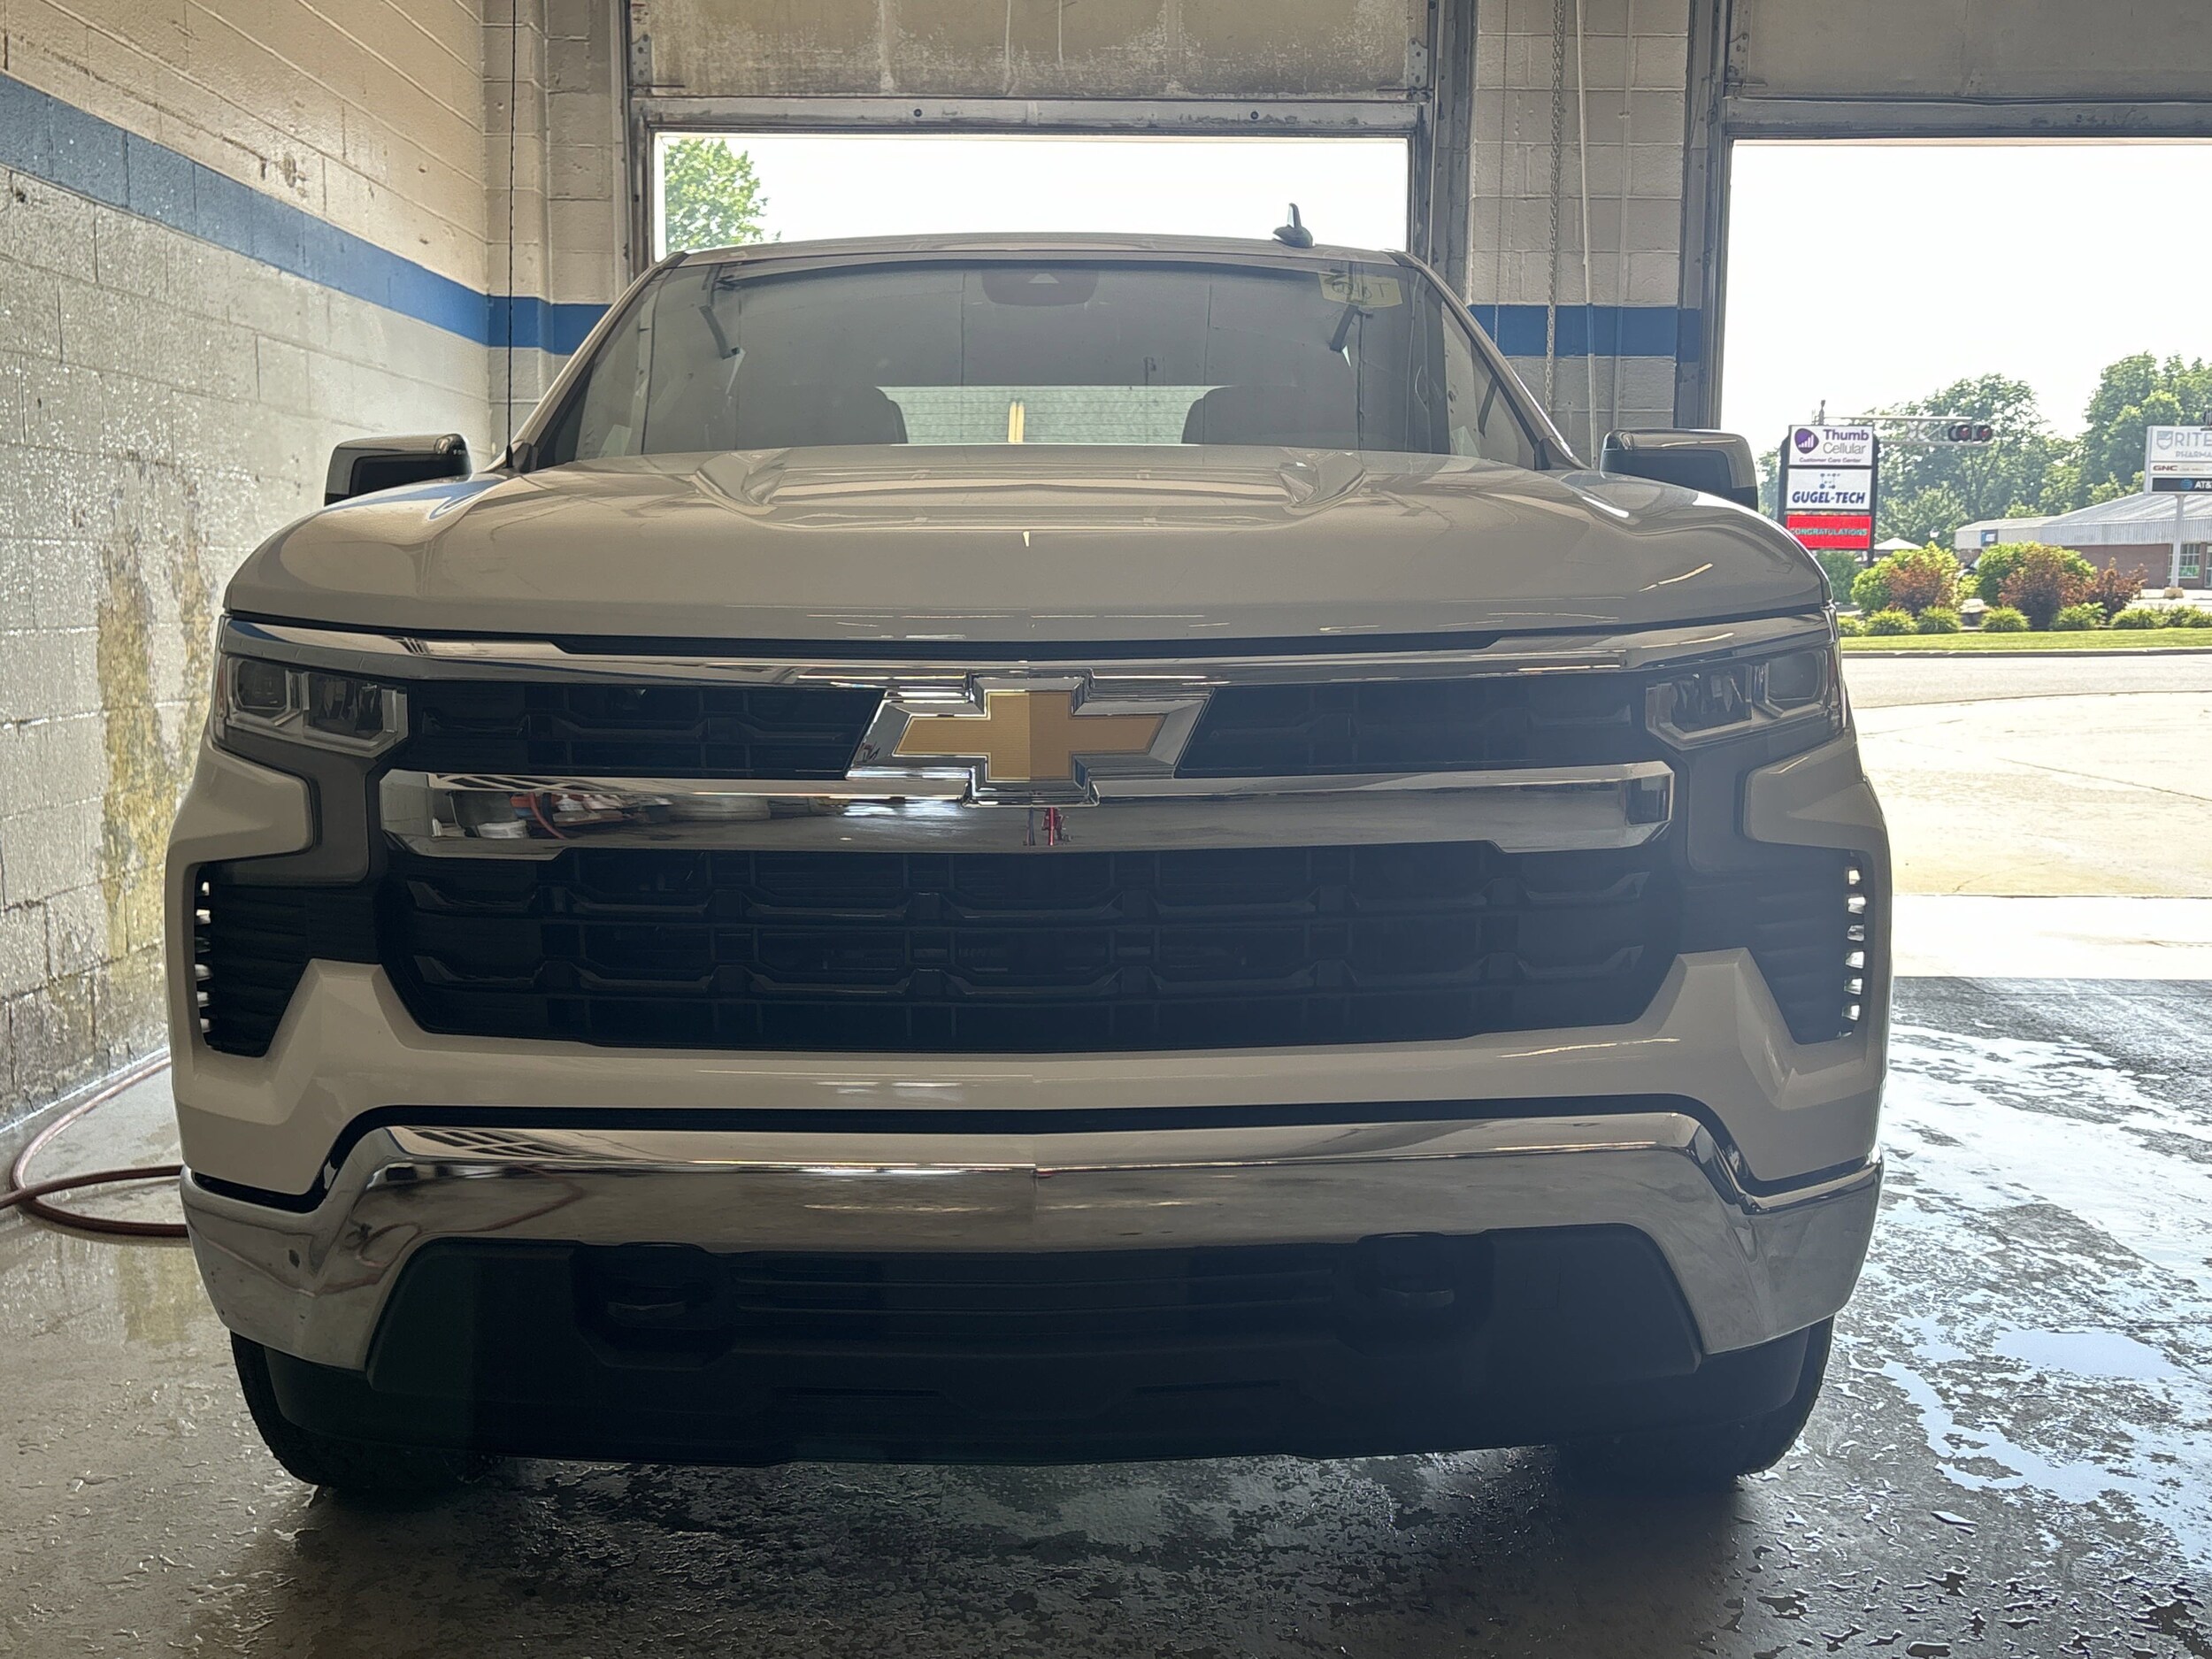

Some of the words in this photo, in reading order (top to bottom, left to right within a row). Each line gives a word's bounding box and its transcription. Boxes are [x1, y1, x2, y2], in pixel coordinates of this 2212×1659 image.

[1823, 429, 1870, 441] Thumb
[2175, 432, 2212, 447] RITE
[1823, 442, 1866, 454] Cellular
[1792, 491, 1866, 504] GUGEL-TECH
